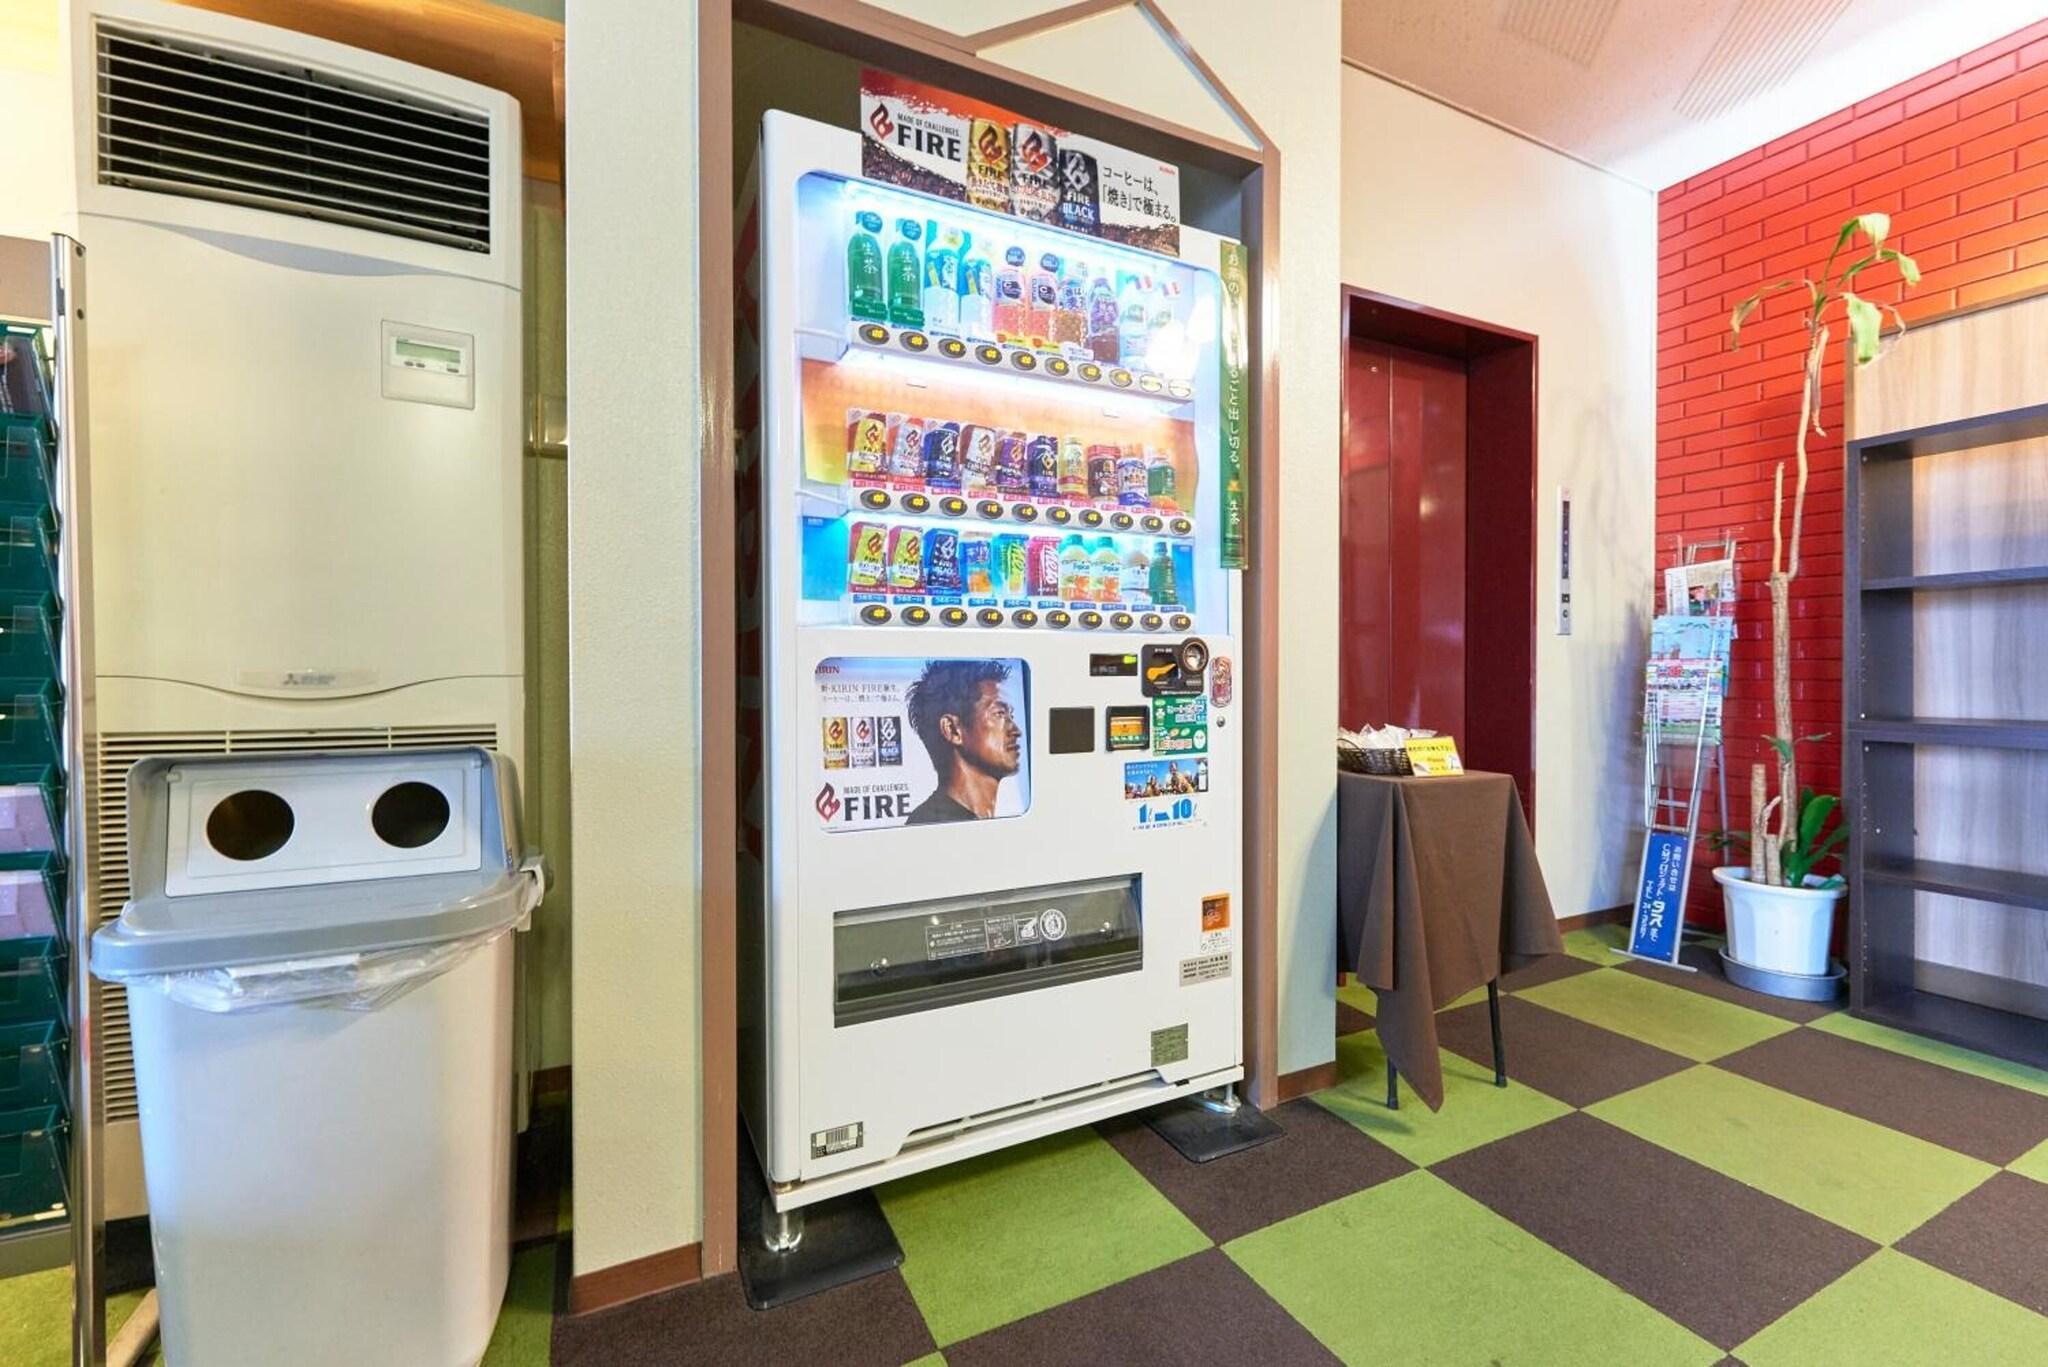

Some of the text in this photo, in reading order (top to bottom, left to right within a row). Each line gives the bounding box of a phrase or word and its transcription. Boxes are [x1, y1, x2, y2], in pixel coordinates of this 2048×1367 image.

[897, 123, 961, 163] FIRE
[1103, 166, 1159, 196] コーヒーは、
[1062, 202, 1095, 222] BLACK
[1066, 191, 1091, 207] FIRE
[1102, 183, 1177, 223] 「焼き」で極まる。
[844, 793, 912, 822] FIRE
